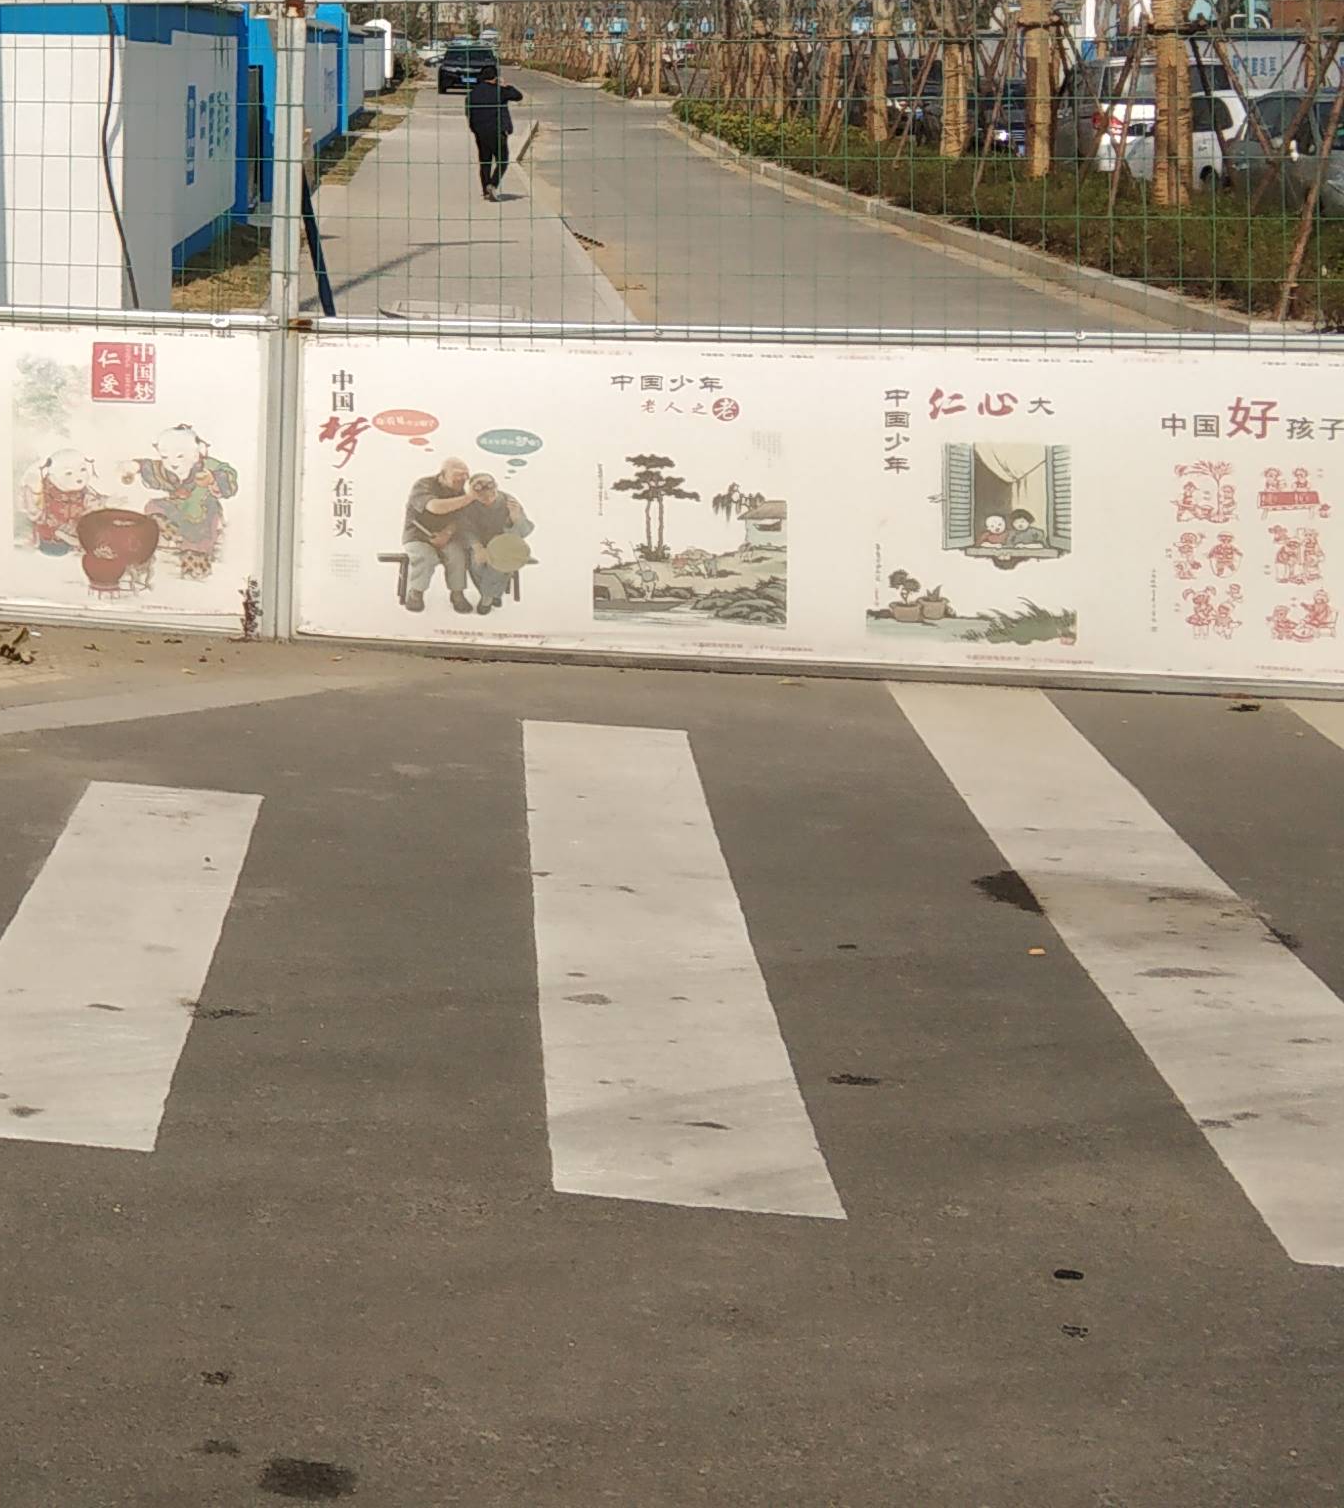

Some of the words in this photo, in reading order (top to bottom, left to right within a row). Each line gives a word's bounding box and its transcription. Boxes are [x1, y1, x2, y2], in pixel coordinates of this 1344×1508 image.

[97, 348, 122, 397] 仁爱
[133, 342, 155, 402] 中国梦
[610, 374, 724, 393] 中国少年
[640, 396, 740, 422] 老人之老
[928, 386, 1056, 420] 仁心大
[1161, 396, 1344, 441] 中国好孩子
[884, 388, 911, 475] 中国少年
